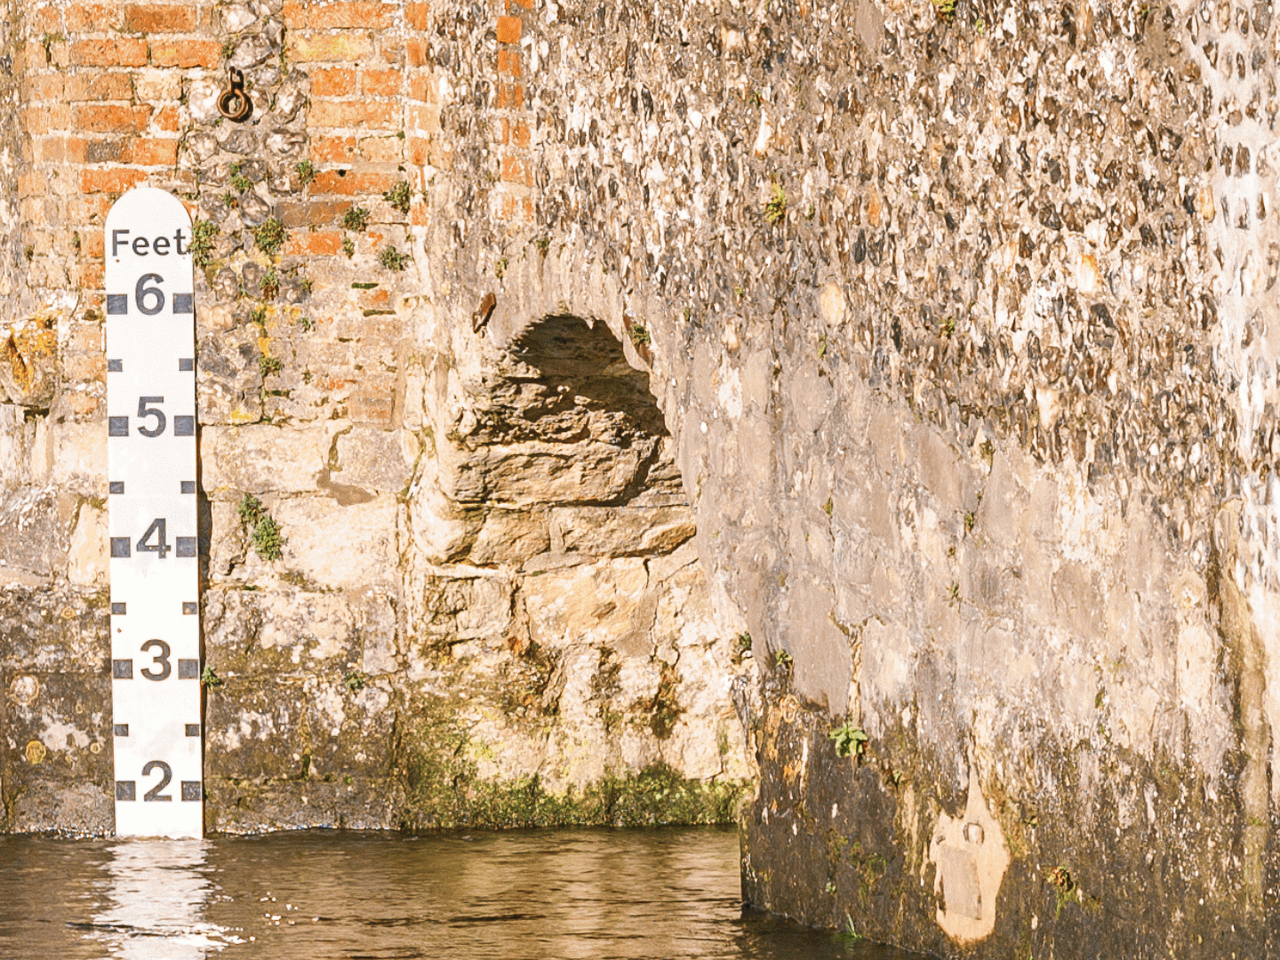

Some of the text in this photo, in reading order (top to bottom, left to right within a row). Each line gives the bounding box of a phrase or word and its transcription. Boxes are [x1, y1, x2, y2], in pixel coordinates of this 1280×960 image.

[112, 228, 190, 257] Feet
[135, 272, 166, 316] 6
[137, 396, 167, 438] 5
[135, 517, 172, 559] 4
[140, 639, 172, 681] 3
[141, 760, 173, 802] 2
